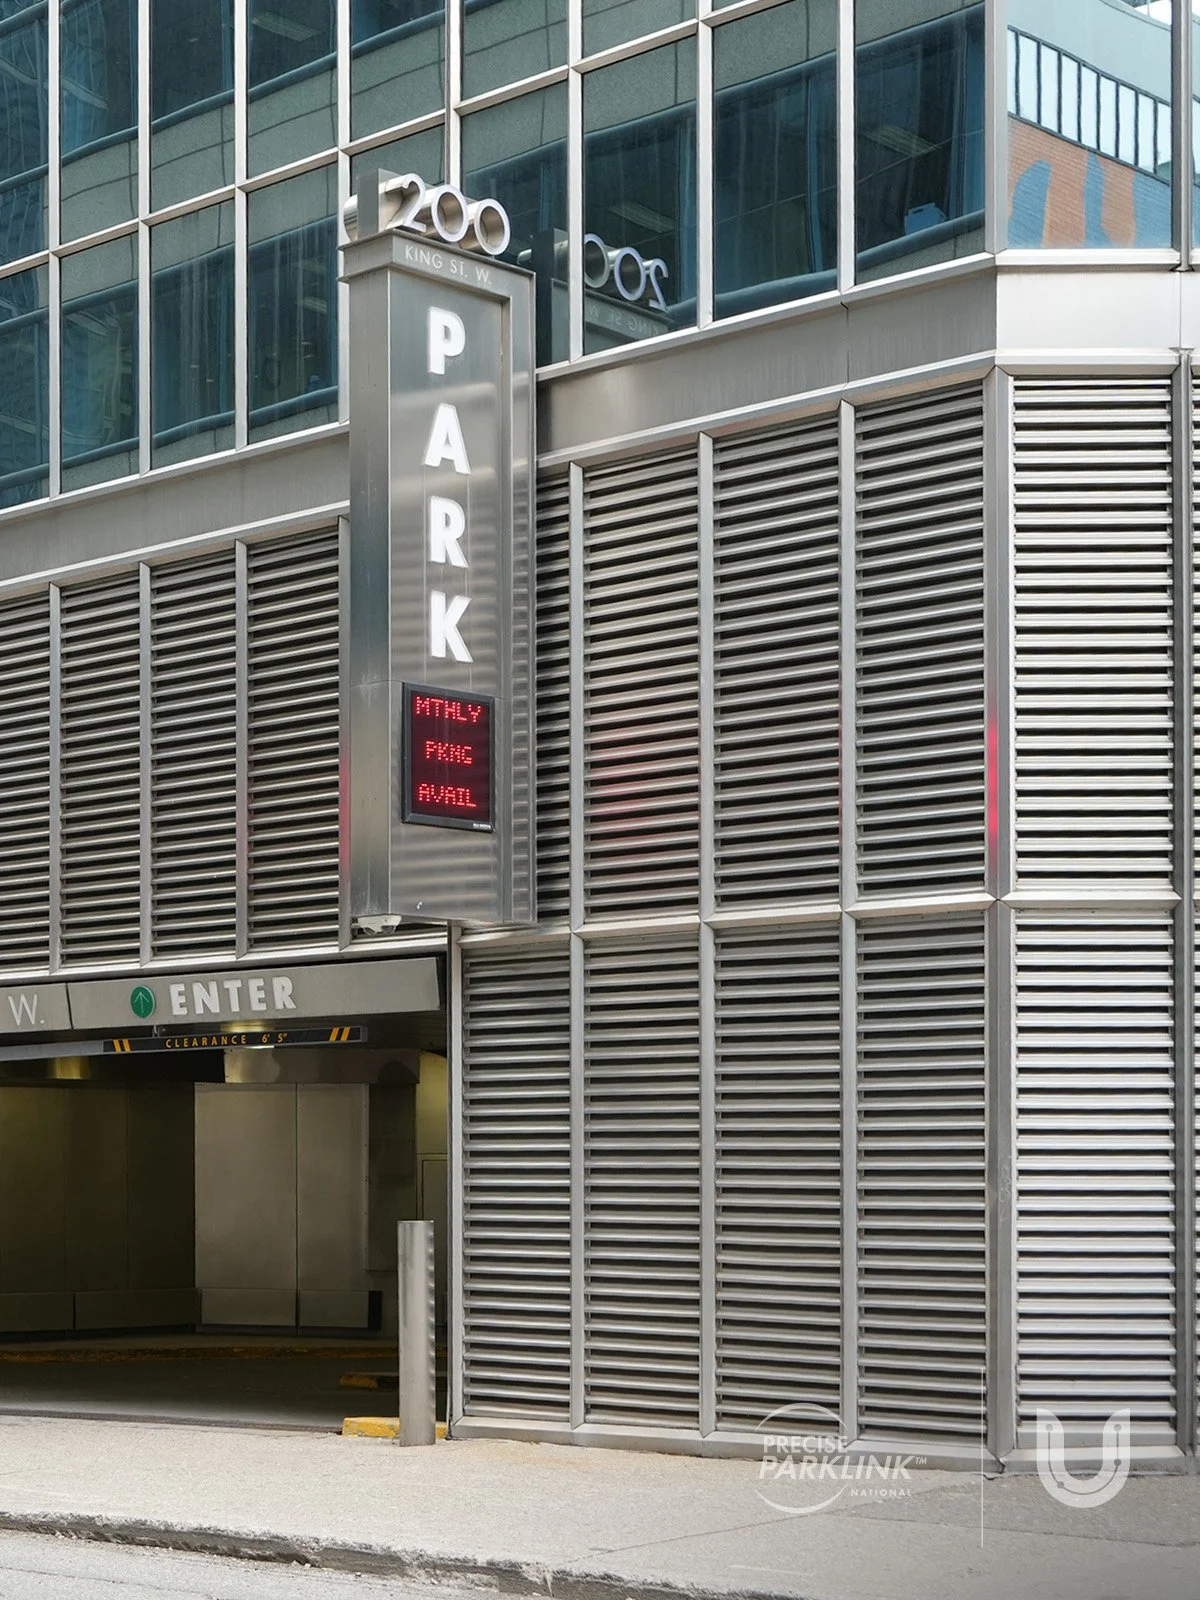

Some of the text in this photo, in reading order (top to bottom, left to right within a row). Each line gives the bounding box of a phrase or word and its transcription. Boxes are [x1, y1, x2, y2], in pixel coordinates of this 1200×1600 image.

[385, 173, 511, 256] 200
[403, 245, 492, 285] KING ST. W.
[424, 305, 474, 664] PARK
[415, 695, 482, 724] MTHLY
[425, 740, 473, 766] PKNG
[417, 783, 477, 808] AVAIL
[8, 993, 46, 1026] W.
[169, 975, 298, 1017] ENTER
[165, 1034, 248, 1049] CLEARANCE
